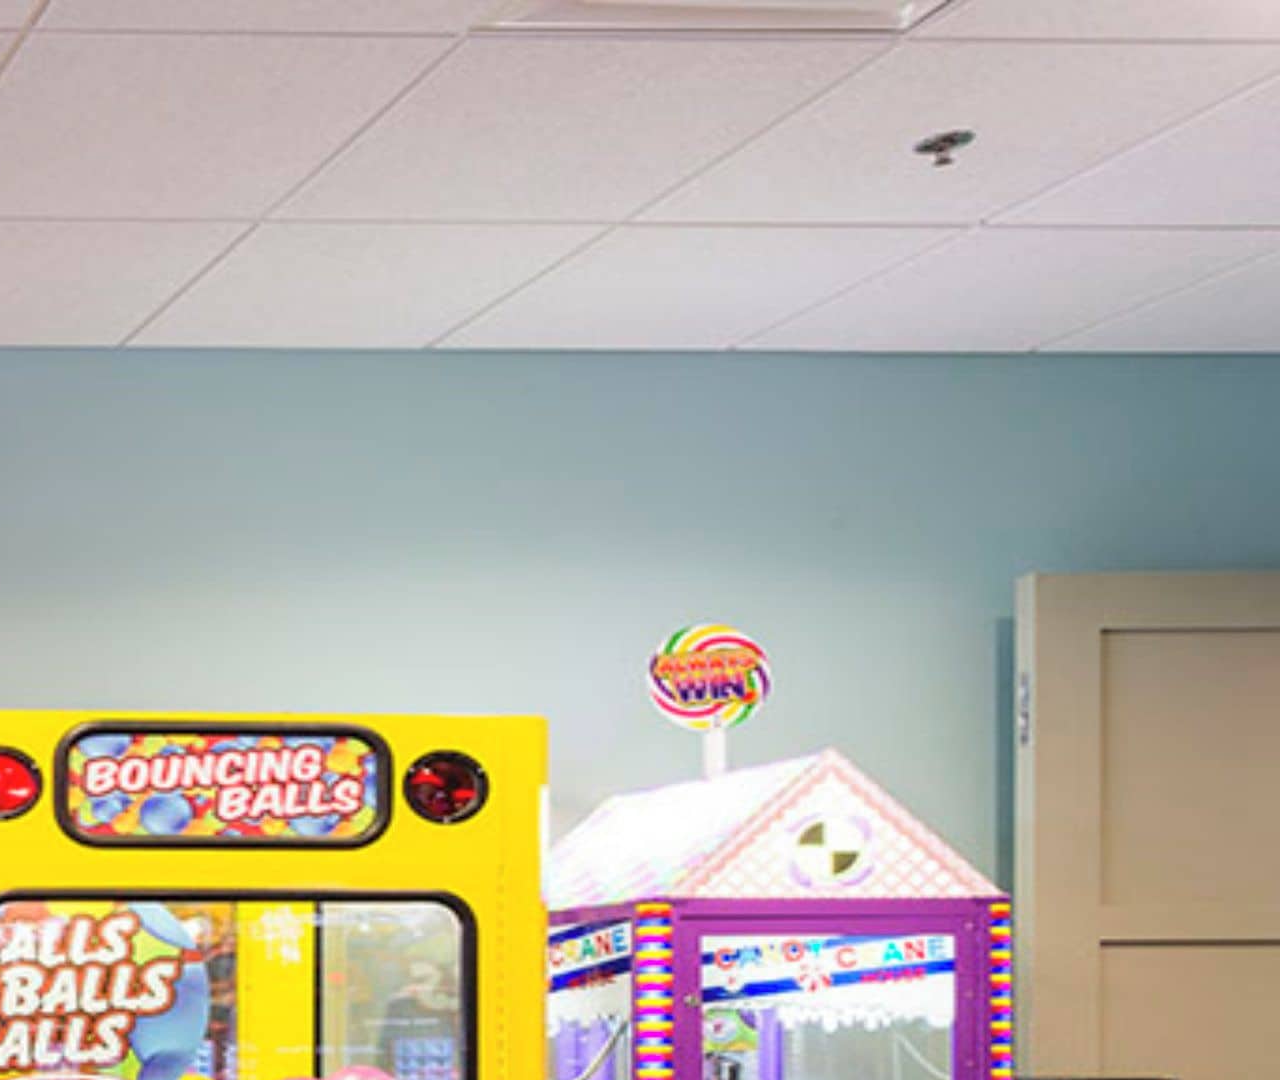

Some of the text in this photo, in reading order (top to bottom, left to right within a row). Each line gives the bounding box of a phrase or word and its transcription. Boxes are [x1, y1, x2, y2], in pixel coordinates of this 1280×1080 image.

[674, 671, 745, 702] WIN
[85, 748, 323, 793] BOUNCING
[217, 780, 362, 820] BALLS
[835, 935, 947, 968] CANE
[0, 960, 180, 1017] BALLS
